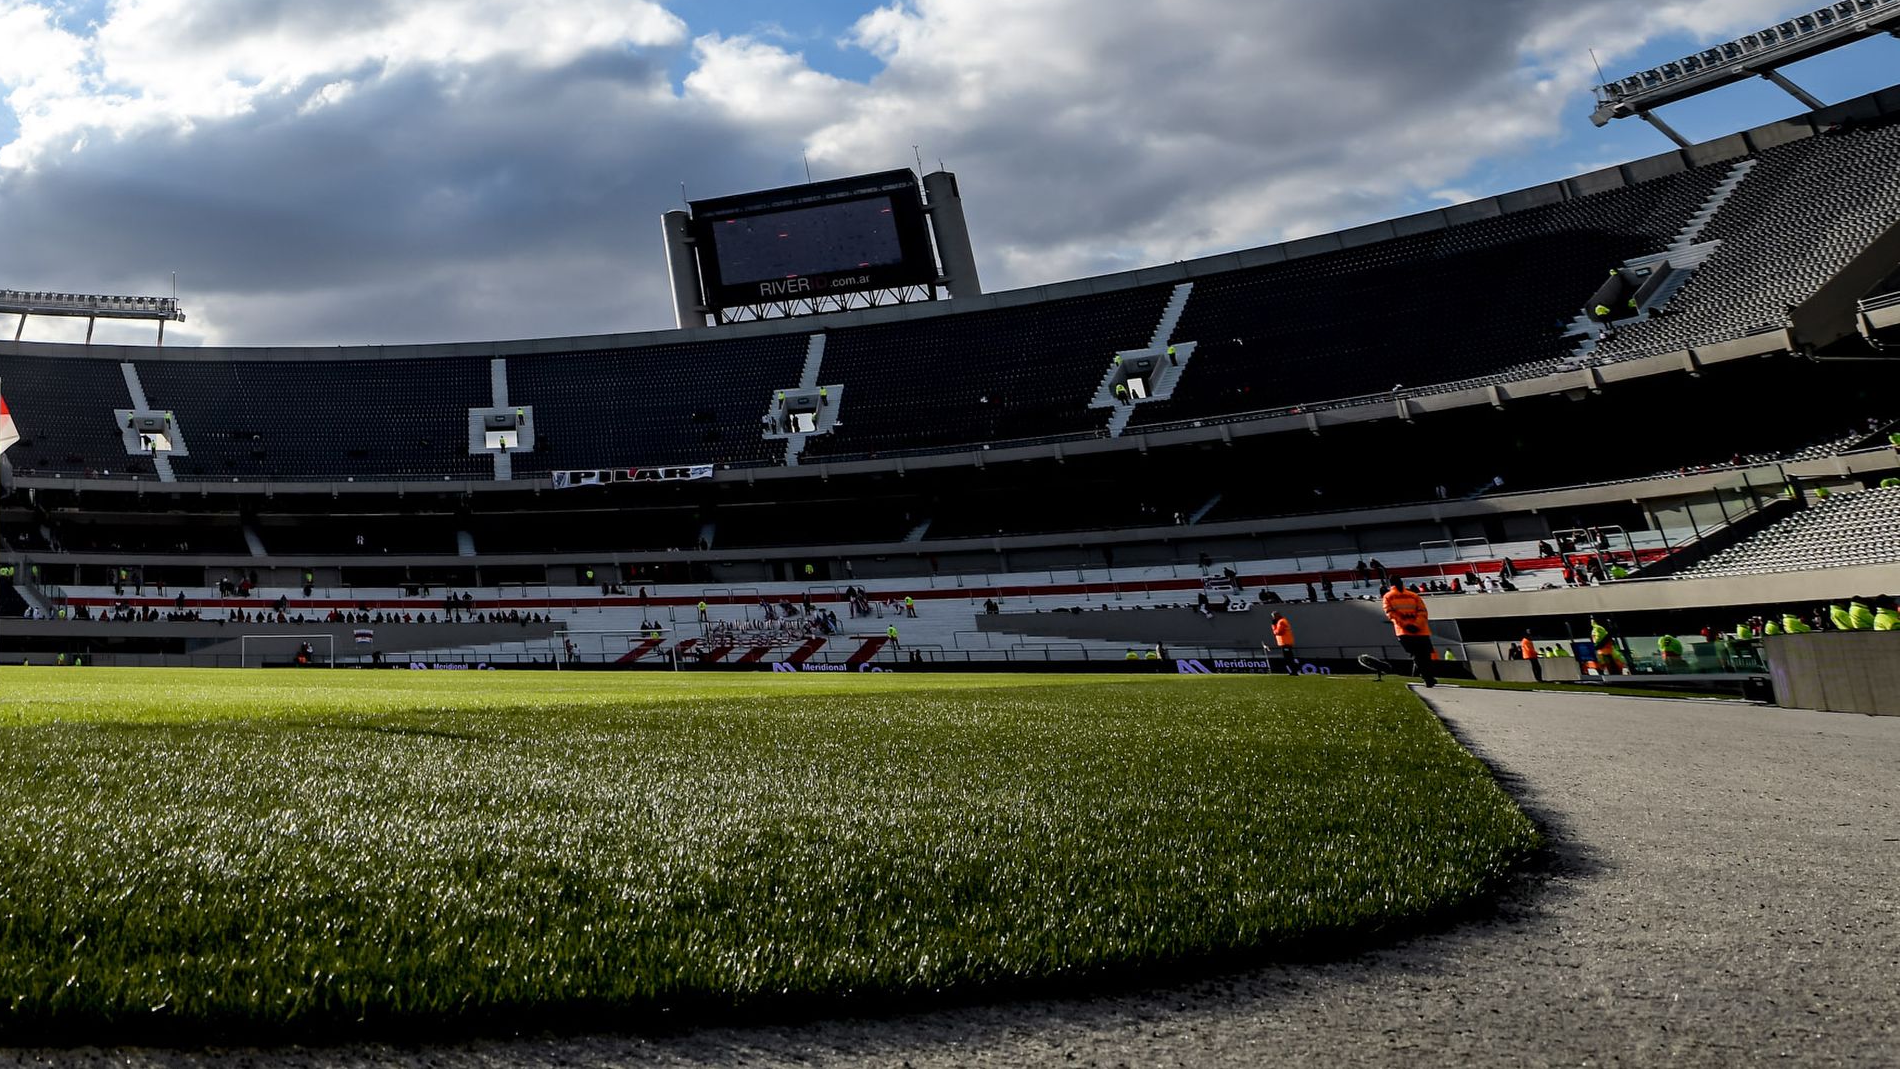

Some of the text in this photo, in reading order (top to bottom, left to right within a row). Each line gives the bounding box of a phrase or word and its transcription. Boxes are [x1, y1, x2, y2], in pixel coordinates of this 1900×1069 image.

[569, 466, 691, 484] PILAR
[802, 663, 847, 671] Meridional
[1214, 659, 1269, 669] Meridional
